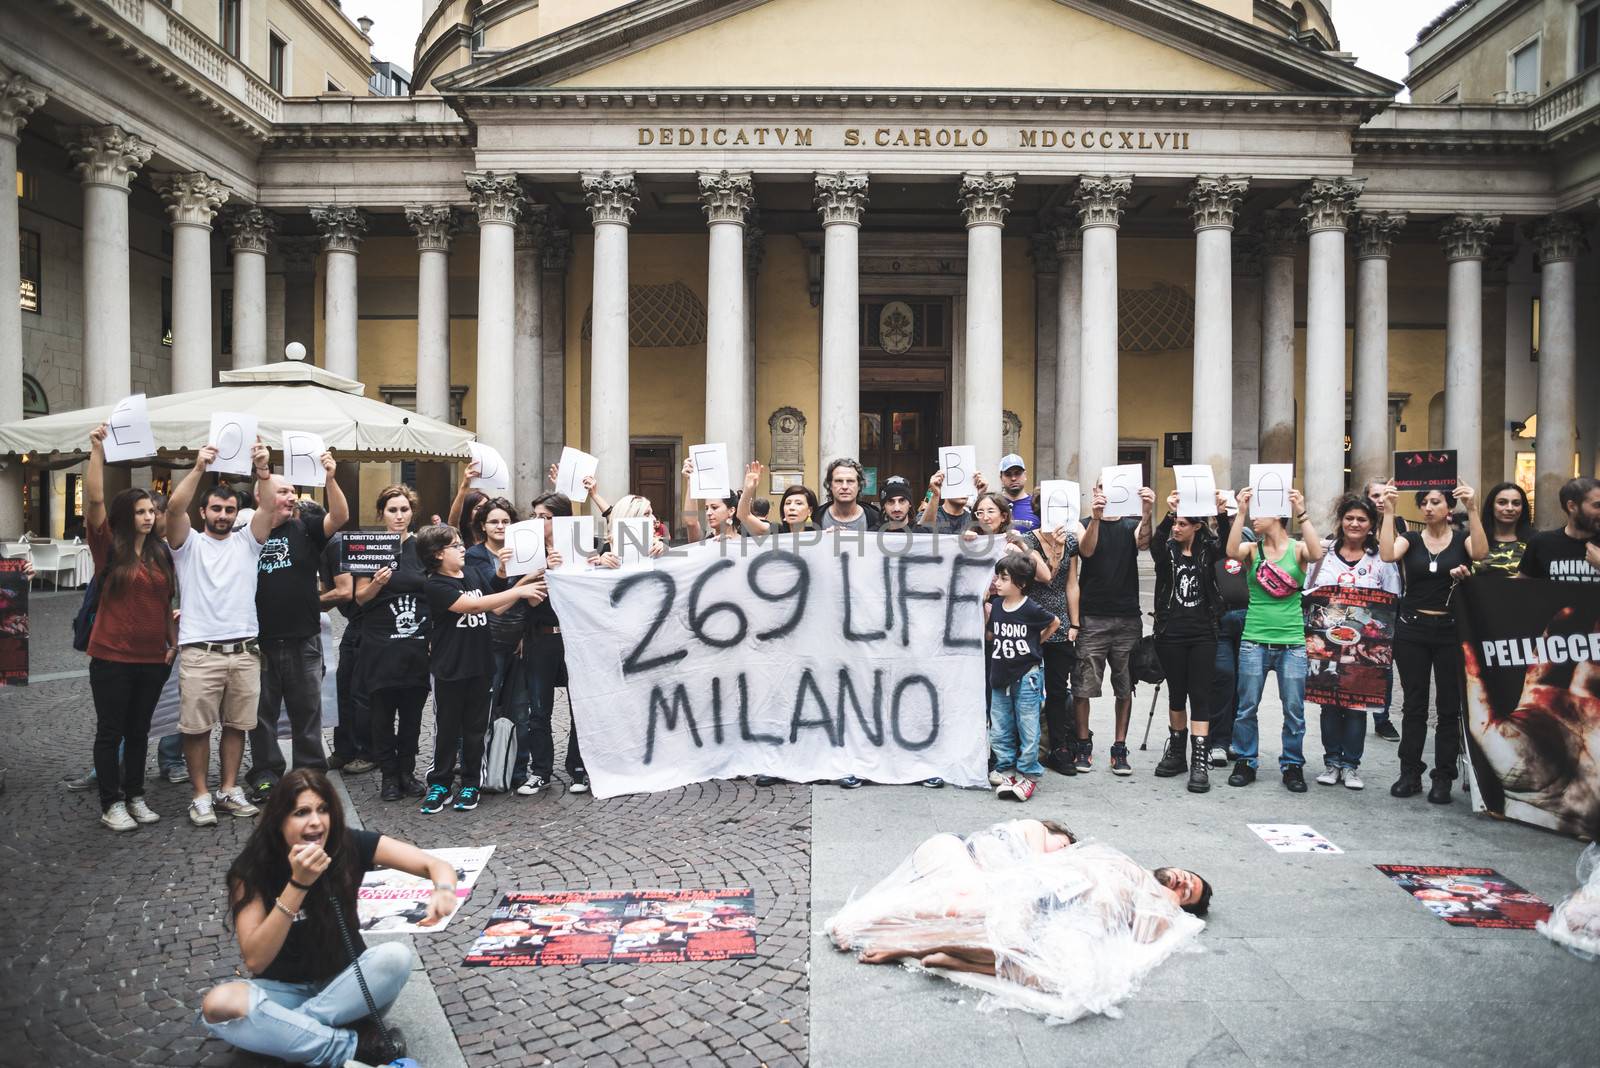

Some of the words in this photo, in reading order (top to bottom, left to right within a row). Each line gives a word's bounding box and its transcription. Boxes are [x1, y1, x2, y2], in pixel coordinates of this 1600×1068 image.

[637, 127, 814, 147] DEDICATVM
[1019, 129, 1190, 150] MDCCCXLVII
[215, 421, 244, 461] O
[287, 435, 318, 477] R
[694, 449, 724, 491] E
[945, 452, 967, 487] B
[1047, 488, 1070, 525] A
[1111, 473, 1130, 504] S
[1180, 474, 1210, 505] T
[1256, 471, 1285, 508] A
[513, 528, 541, 564] D
[609, 549, 812, 675] 269
[840, 551, 997, 649] LIFE
[1001, 622, 1027, 638] SONO
[991, 638, 1031, 659] 269
[1482, 633, 1600, 667] PELLICCE
[642, 667, 940, 765] MILANO
